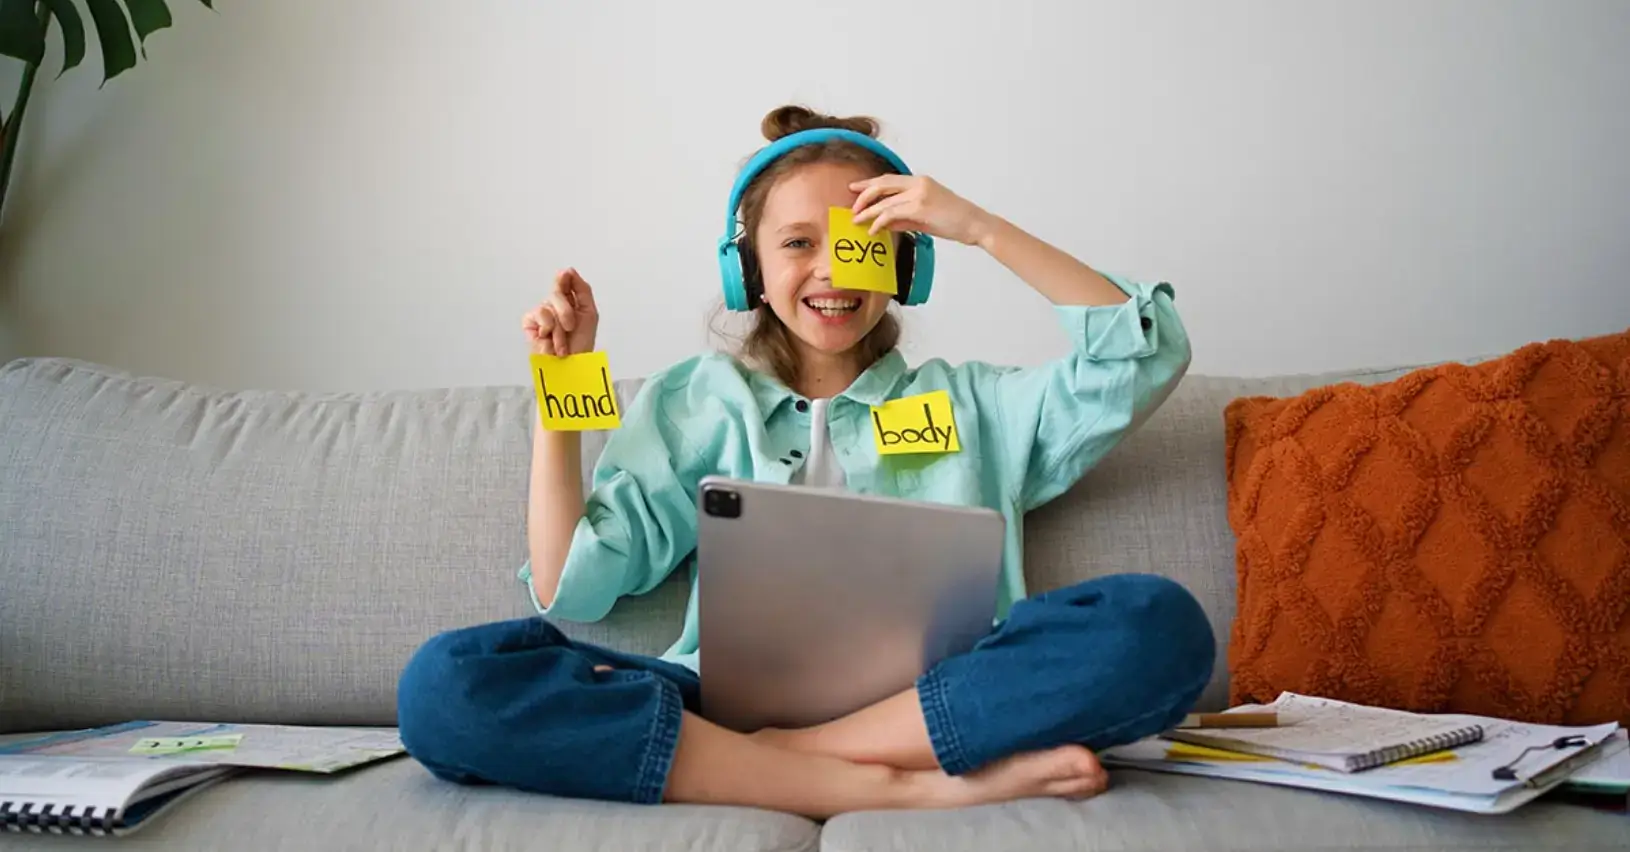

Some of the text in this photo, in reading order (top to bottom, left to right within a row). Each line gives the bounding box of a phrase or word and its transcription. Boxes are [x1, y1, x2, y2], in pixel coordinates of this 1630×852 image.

[834, 238, 888, 267] eye
[538, 366, 616, 419] hand
[873, 404, 952, 451] body
